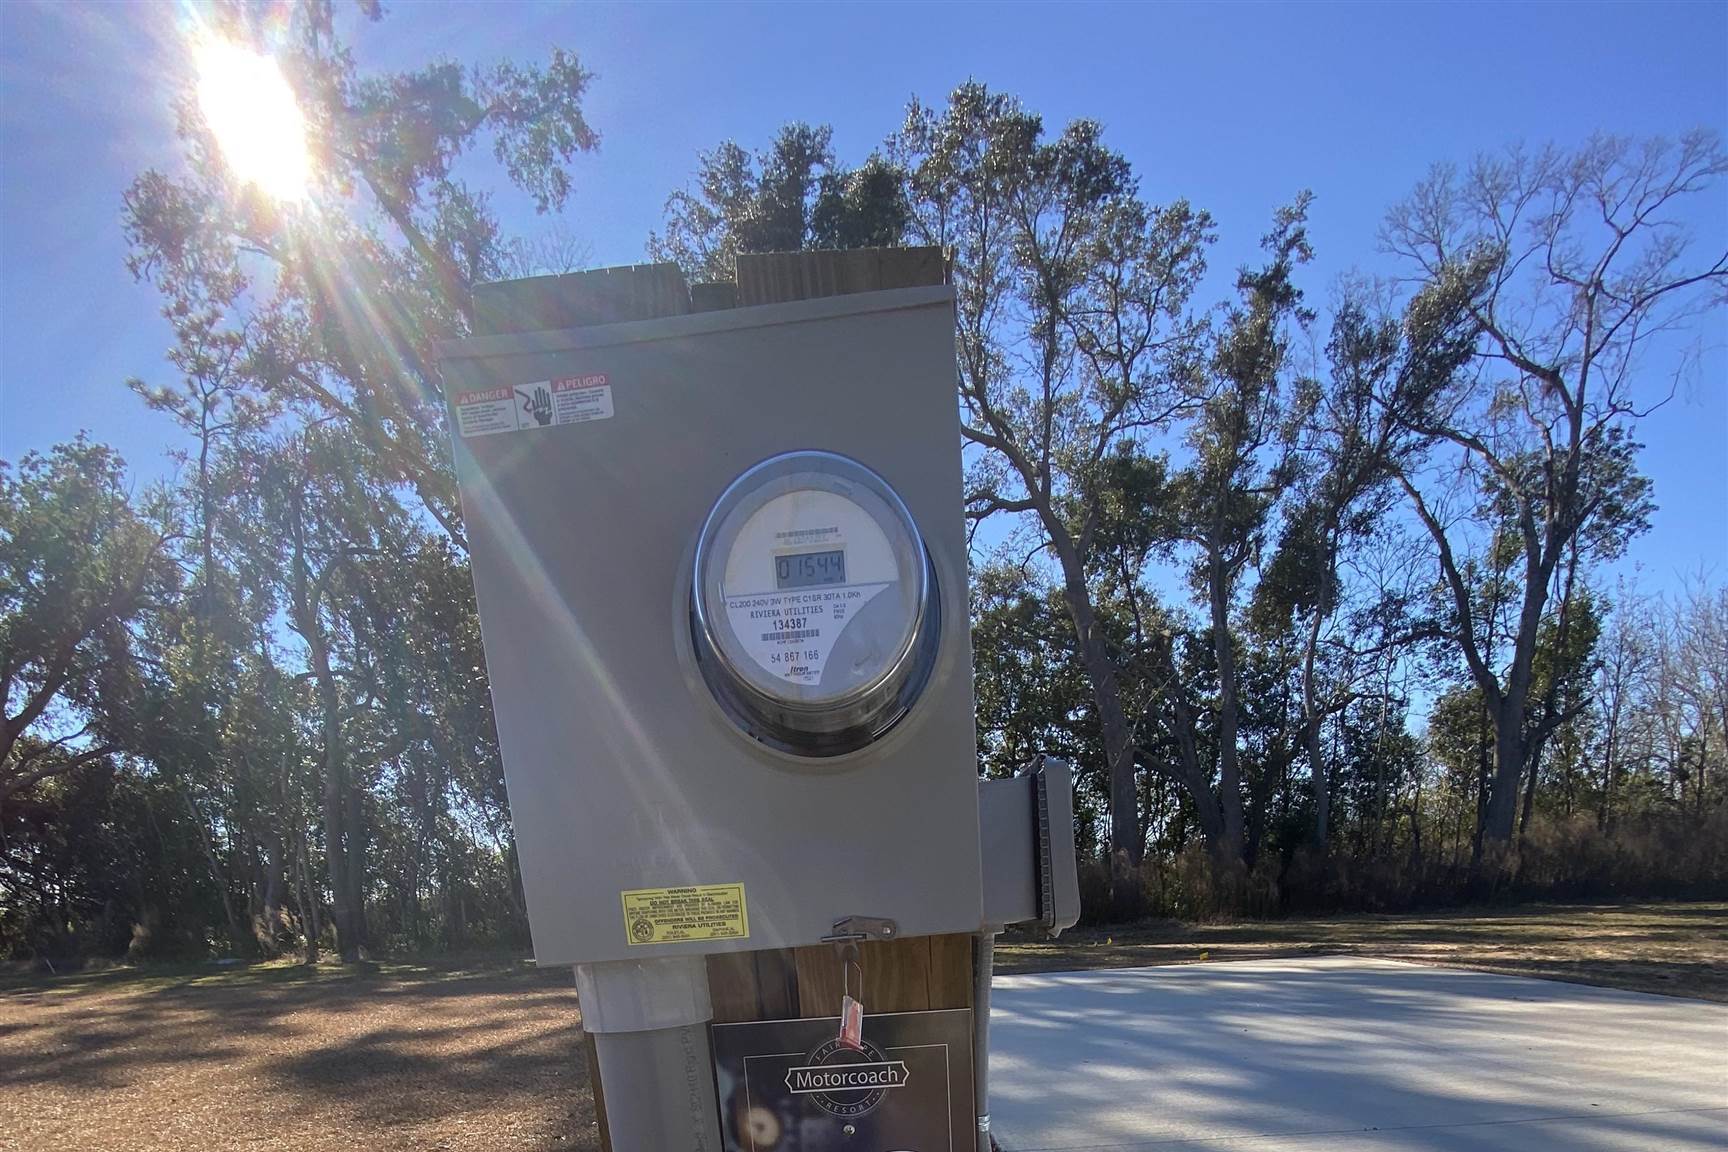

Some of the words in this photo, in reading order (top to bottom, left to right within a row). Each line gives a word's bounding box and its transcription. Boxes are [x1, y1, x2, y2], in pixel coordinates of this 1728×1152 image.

[566, 375, 606, 389] PELIGRO
[469, 388, 508, 402] DANGER
[778, 556, 841, 580] 01544
[730, 600, 751, 609] CL200
[752, 599, 768, 607] 240V
[784, 595, 801, 604] TYPE
[750, 609, 781, 619] RIVIERA
[784, 605, 824, 616] UTILITIES
[773, 617, 807, 631] 134387
[771, 653, 781, 663] 54
[784, 651, 799, 662] 867
[804, 650, 819, 660] 166
[667, 887, 697, 895] WARNING
[796, 1065, 898, 1088] Motorcoach
[826, 1100, 871, 1114] RESORT
